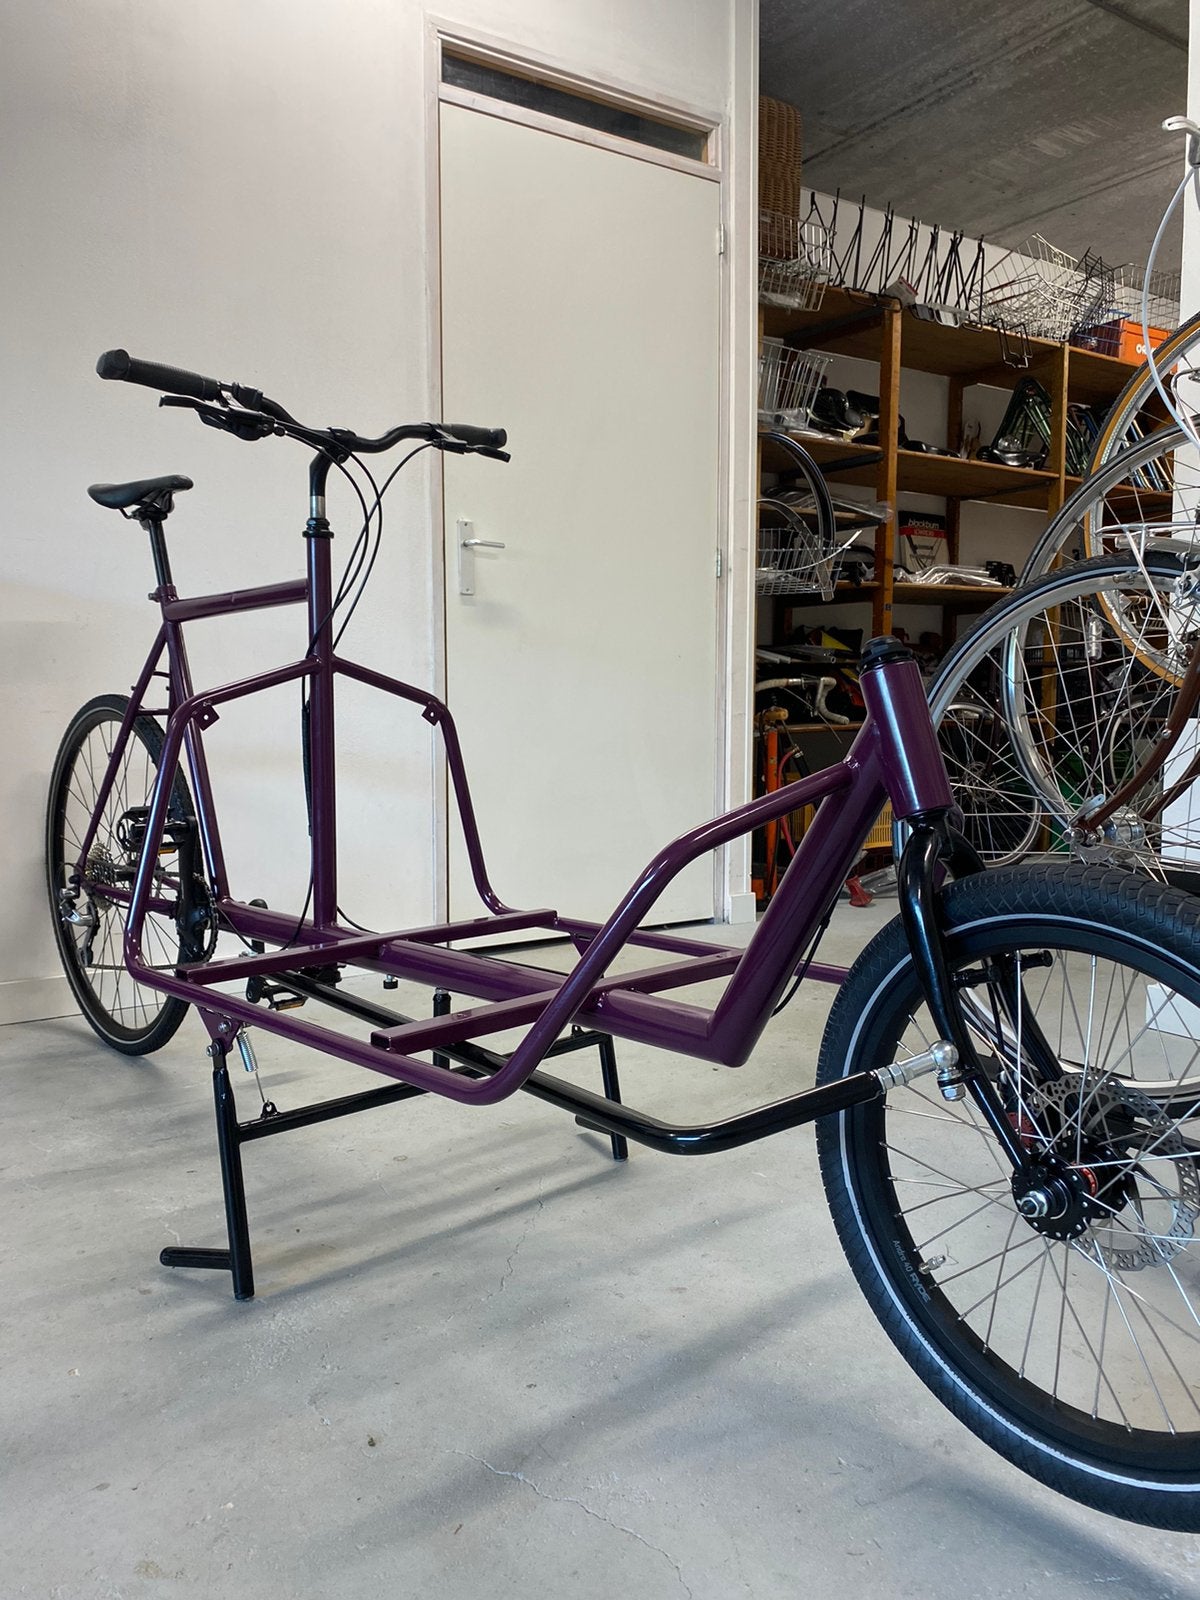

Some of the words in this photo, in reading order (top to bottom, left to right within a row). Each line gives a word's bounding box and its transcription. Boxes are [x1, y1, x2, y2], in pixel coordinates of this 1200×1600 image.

[908, 518, 939, 529] blackburn
[893, 1240, 906, 1261] Andra
[904, 1262, 913, 1272] 40
[910, 1272, 931, 1302] RYDE
